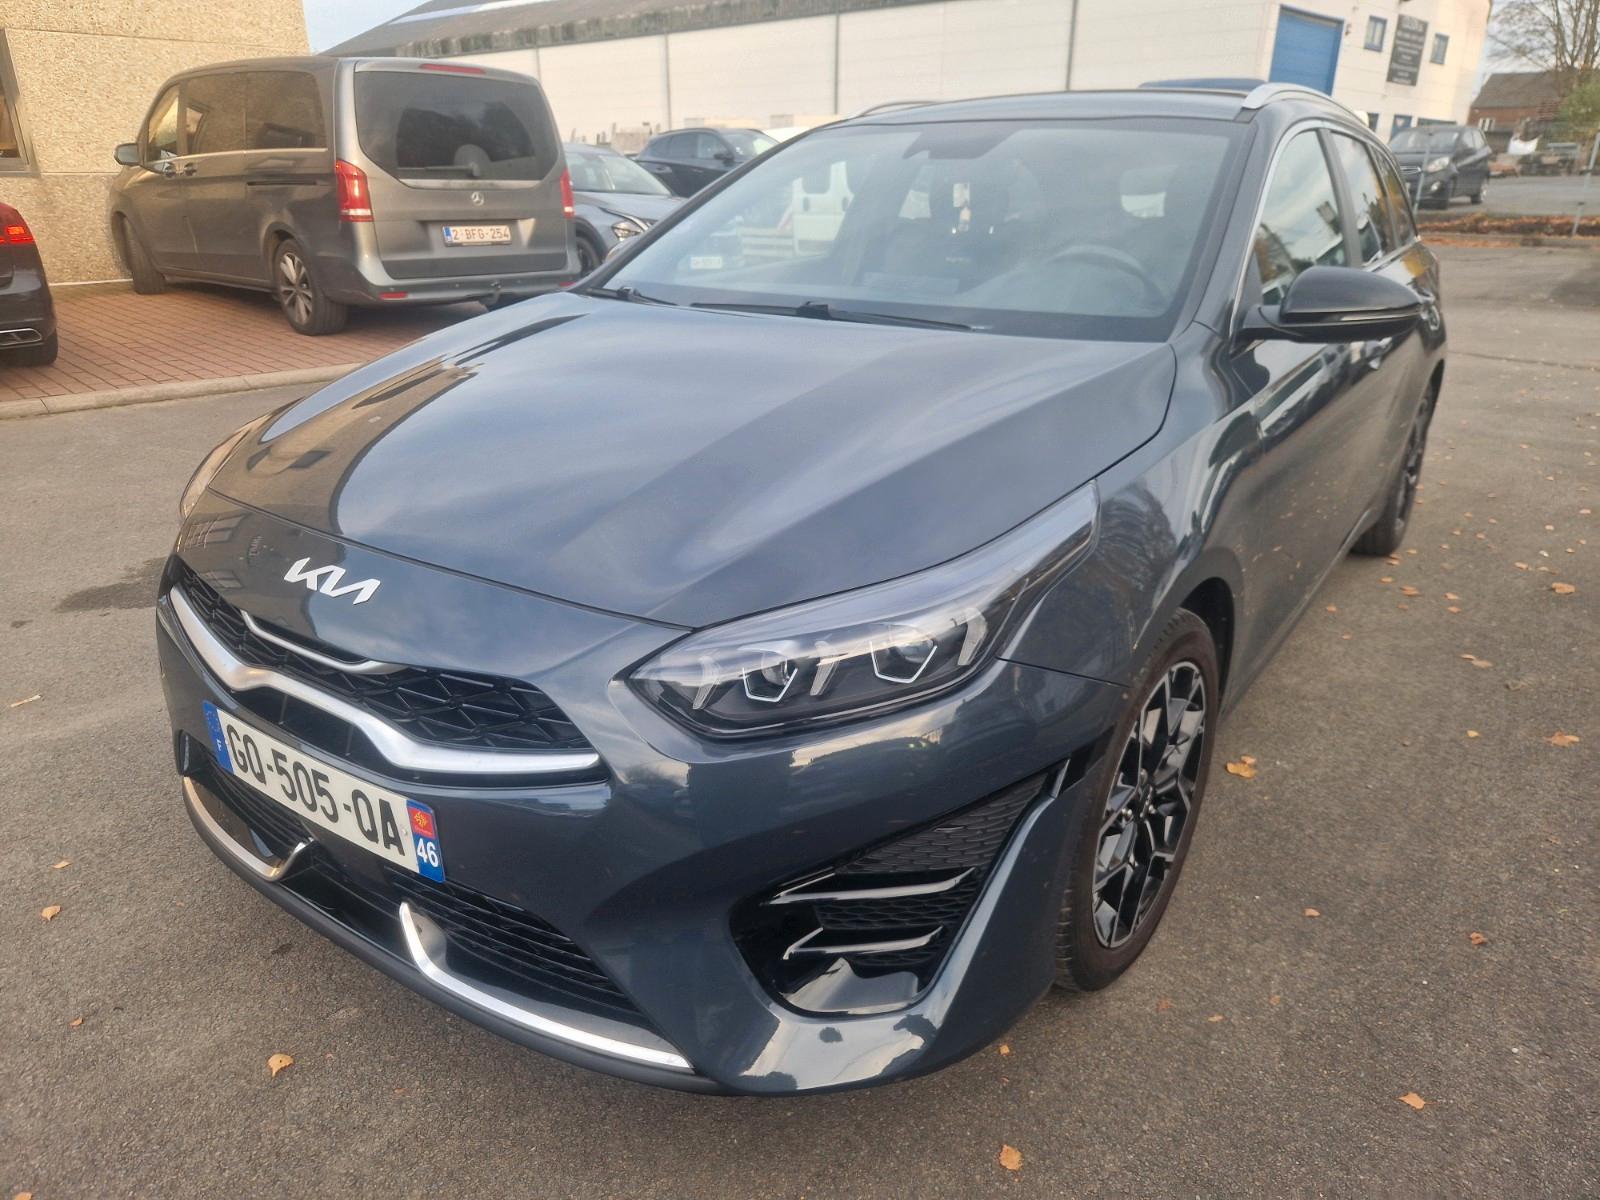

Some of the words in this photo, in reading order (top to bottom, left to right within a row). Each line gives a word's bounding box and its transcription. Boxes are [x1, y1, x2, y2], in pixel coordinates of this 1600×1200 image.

[453, 228, 509, 240] 2-BFG-254
[283, 557, 381, 605] KIA
[216, 738, 222, 752] F
[226, 724, 406, 857] GQ-505-QA
[416, 837, 439, 868] 46
